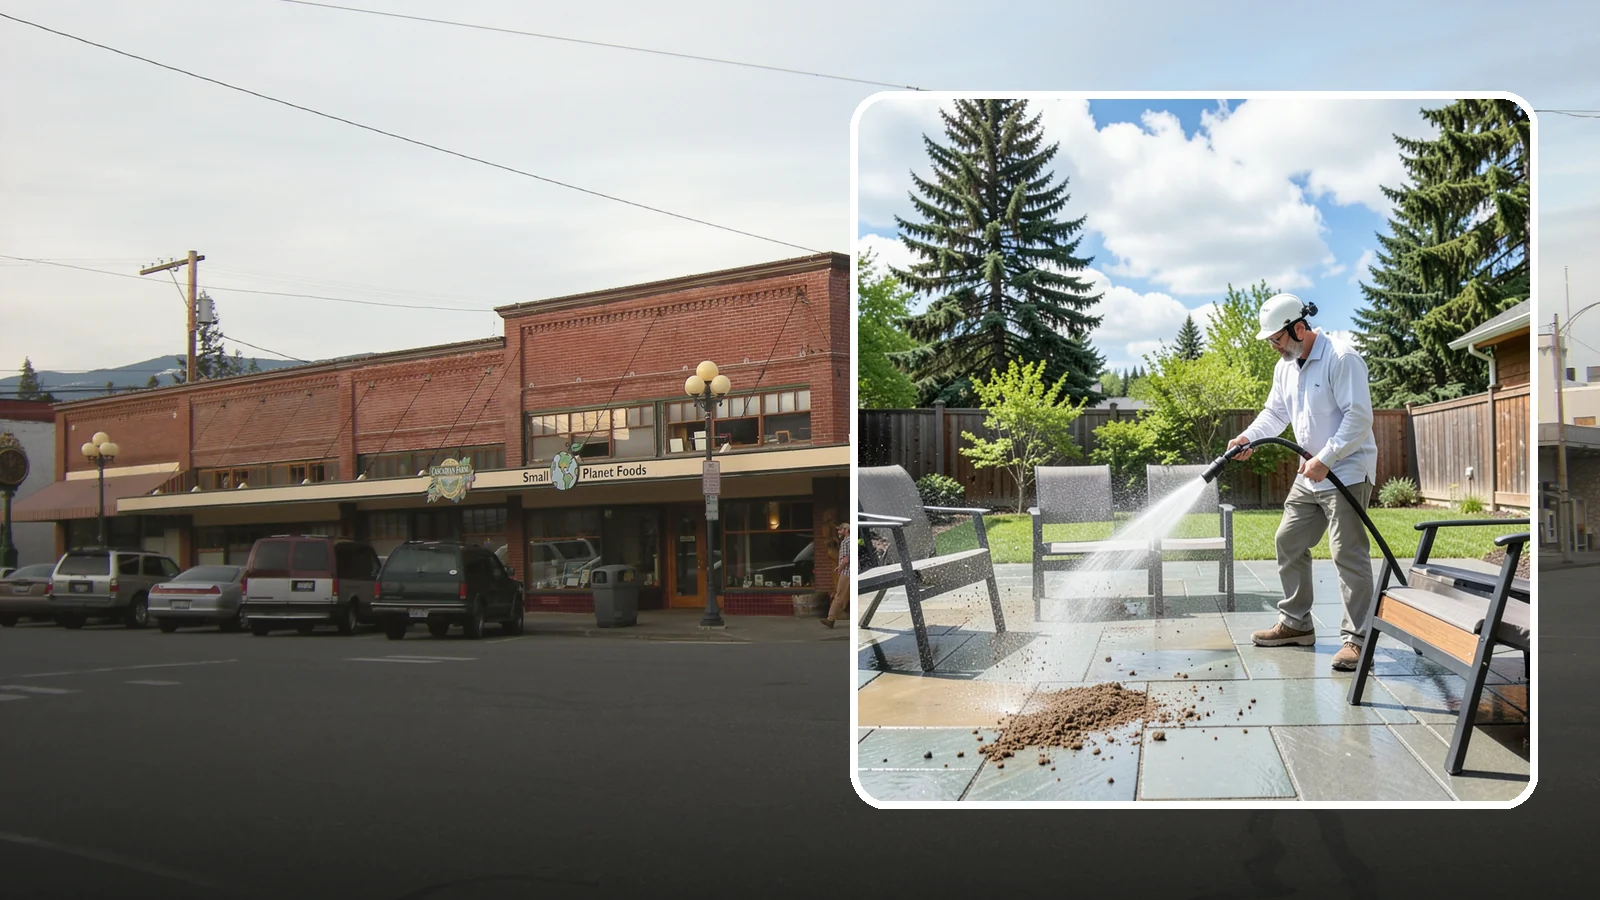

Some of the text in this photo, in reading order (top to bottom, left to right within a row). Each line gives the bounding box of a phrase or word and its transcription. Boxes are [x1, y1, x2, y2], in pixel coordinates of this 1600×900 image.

[523, 464, 647, 483] Small Planet Foods
